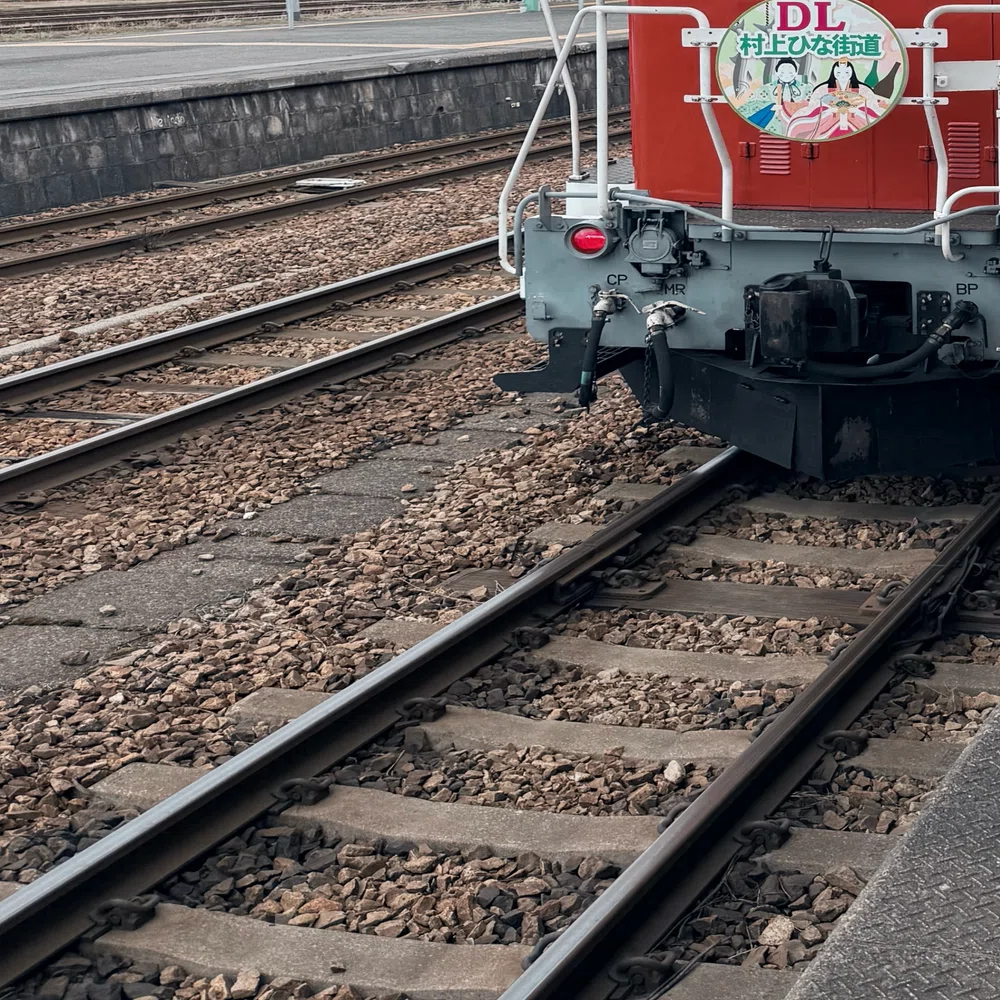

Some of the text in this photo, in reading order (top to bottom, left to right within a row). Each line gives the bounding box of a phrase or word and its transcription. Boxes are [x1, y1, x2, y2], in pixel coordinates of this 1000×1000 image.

[776, 1, 846, 32] DL
[740, 33, 882, 57] 村上ひな街道
[606, 274, 628, 286] CP
[664, 284, 686, 295] MR
[956, 283, 979, 295] BP
